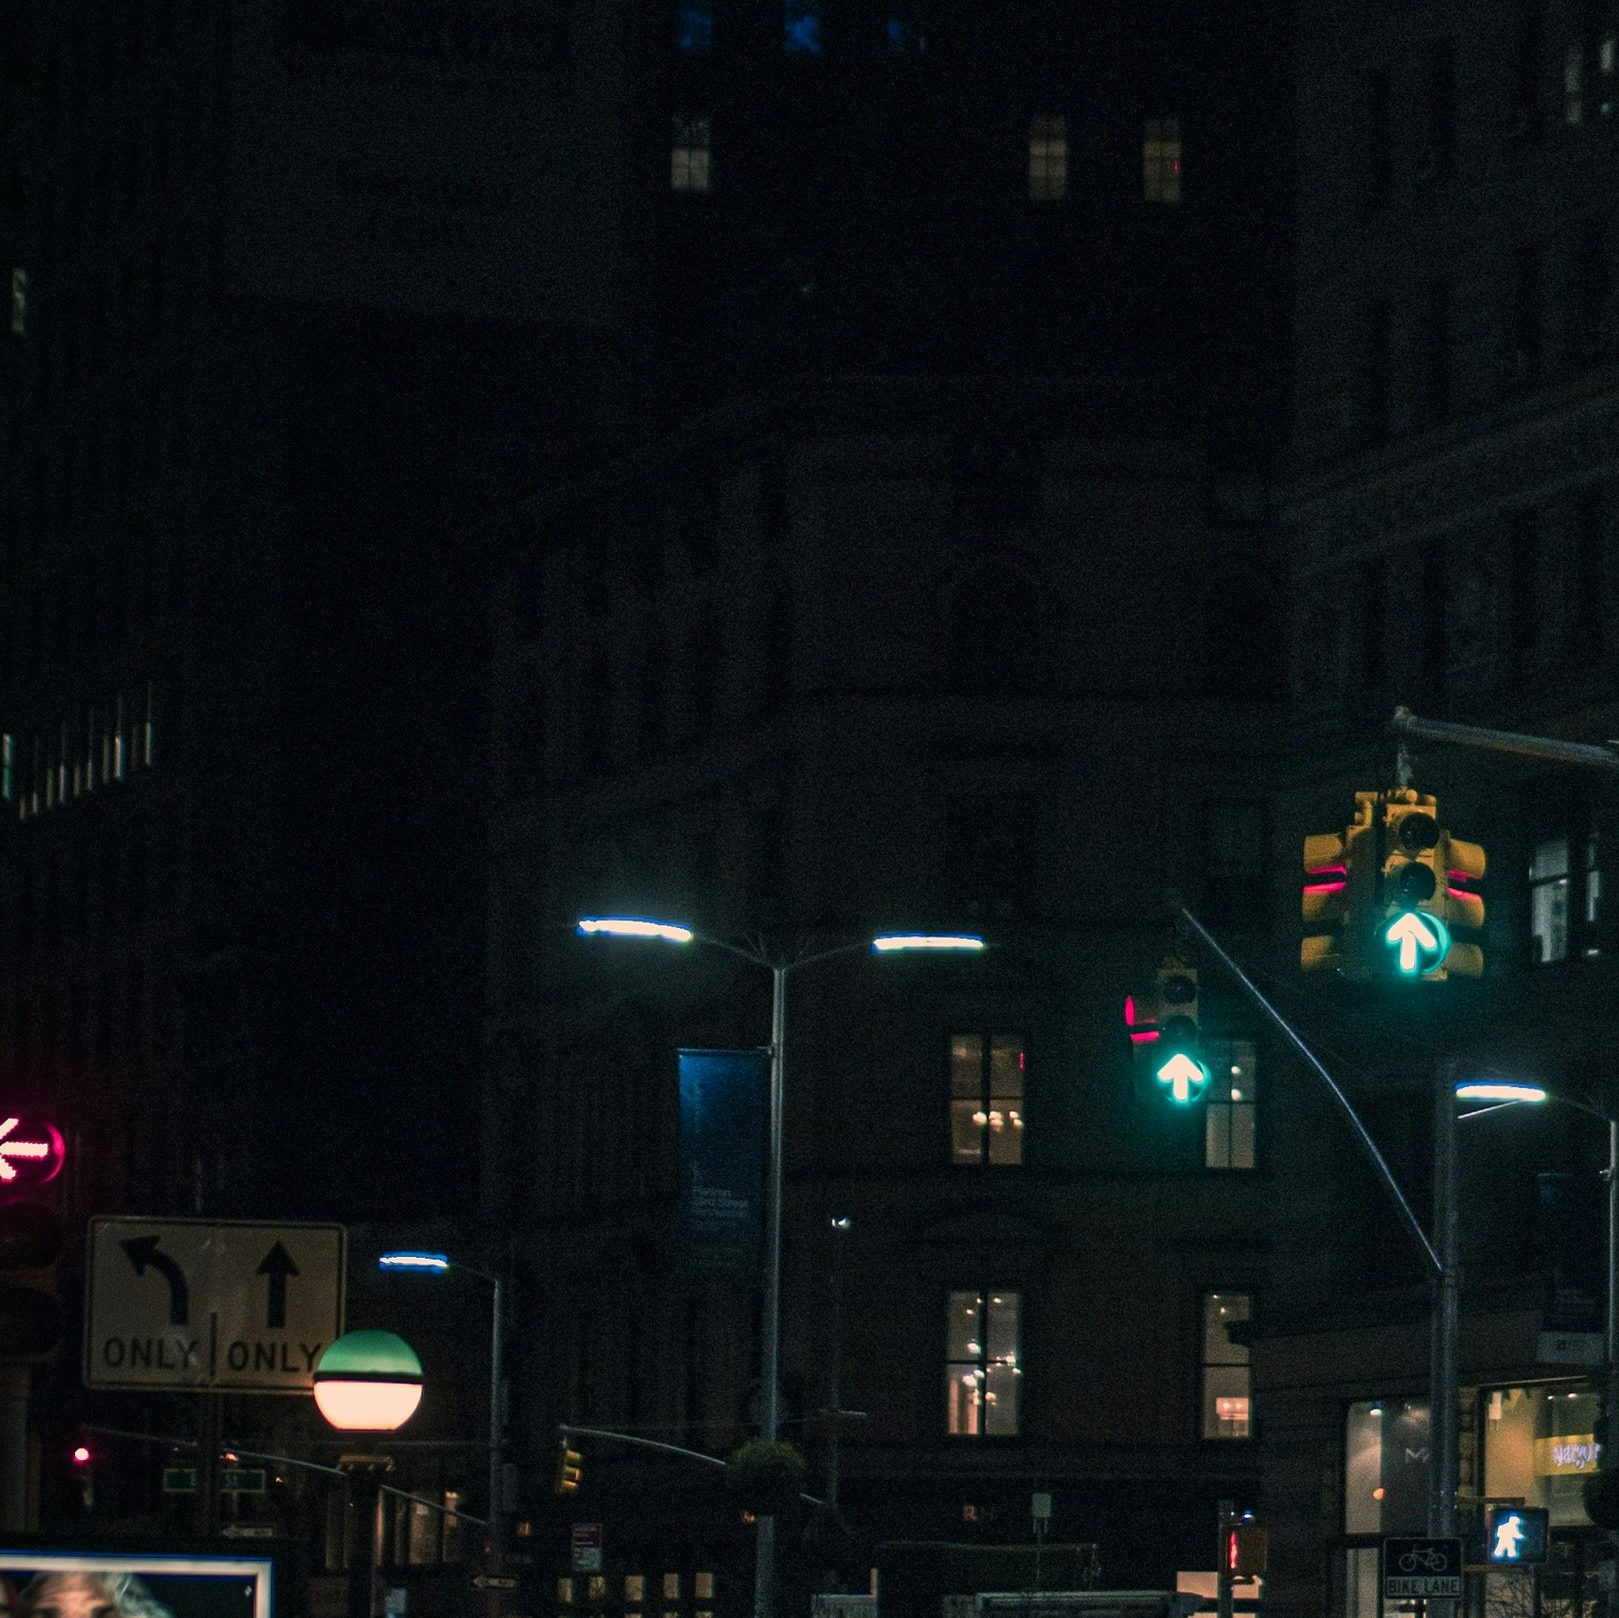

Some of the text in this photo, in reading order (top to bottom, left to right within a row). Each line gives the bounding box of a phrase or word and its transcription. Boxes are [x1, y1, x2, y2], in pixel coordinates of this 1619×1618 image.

[103, 1337, 198, 1370] ONLY
[227, 1341, 322, 1372] ONLY
[1388, 1578, 1459, 1594] BIKE LANE
